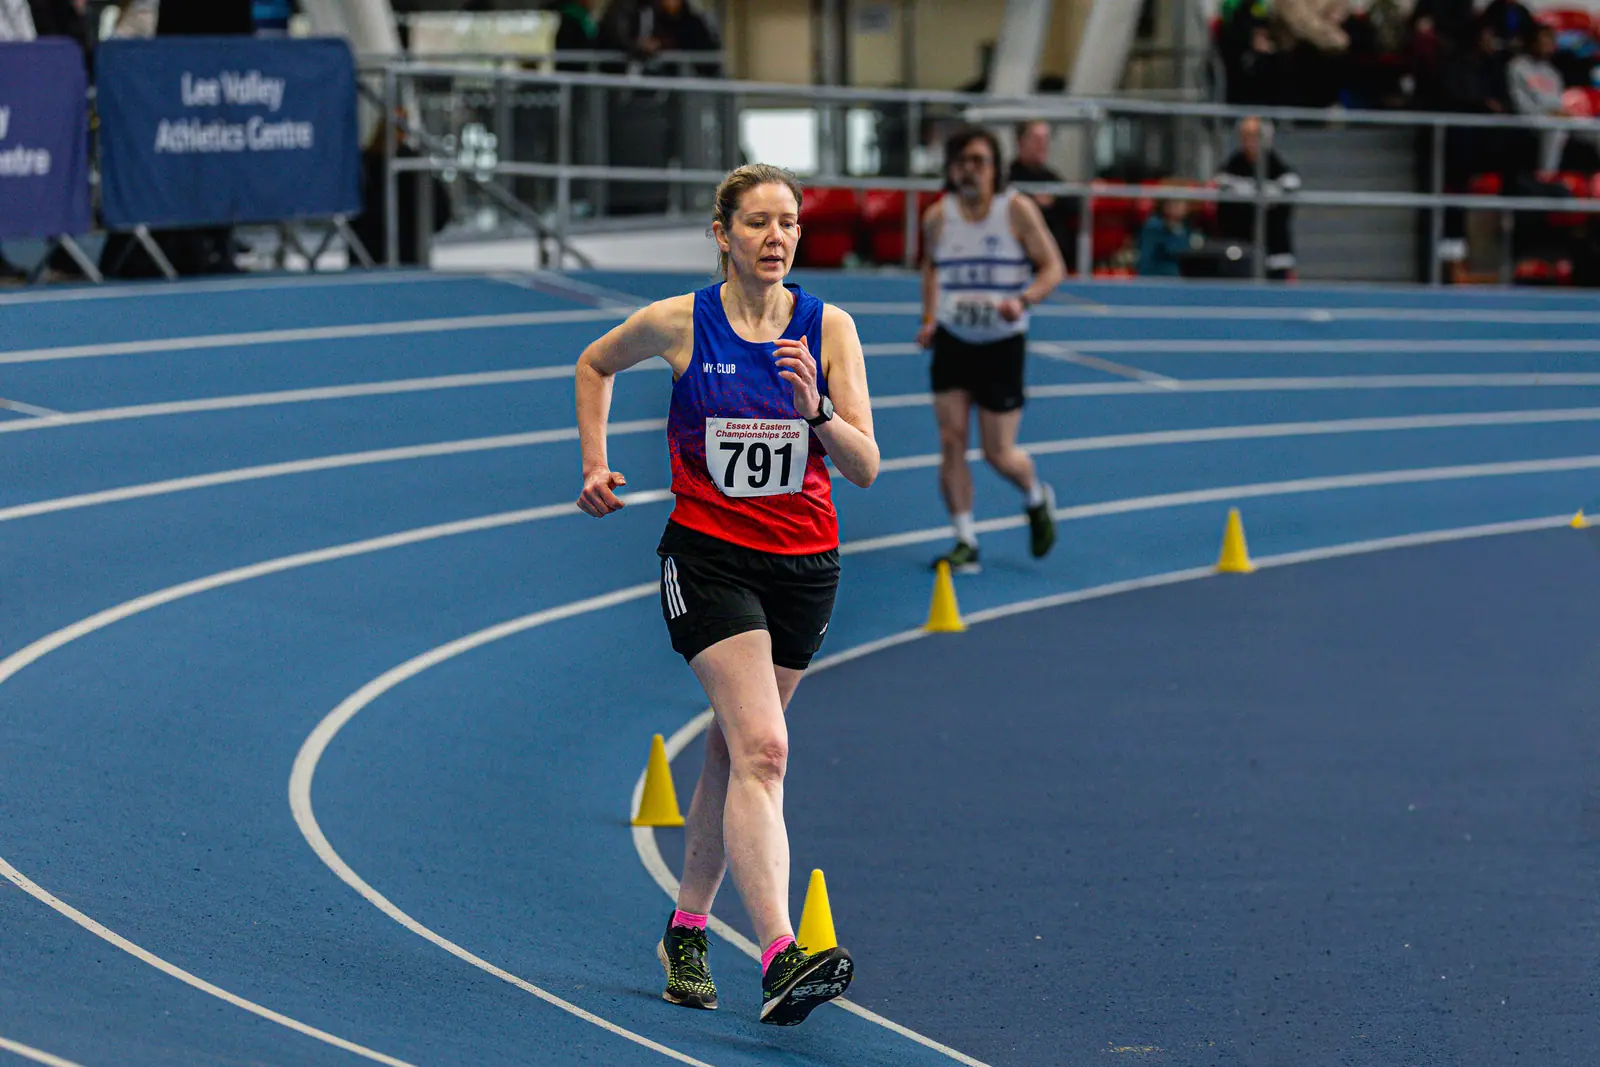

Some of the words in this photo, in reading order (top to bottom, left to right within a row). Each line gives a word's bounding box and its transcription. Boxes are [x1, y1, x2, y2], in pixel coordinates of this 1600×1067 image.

[181, 71, 221, 106] Lee
[220, 70, 285, 112] Valley
[155, 117, 246, 153] Athletics
[246, 115, 314, 150] Centre
[715, 430, 779, 439] Championships
[726, 422, 750, 430] Essex
[719, 441, 792, 488] 791
